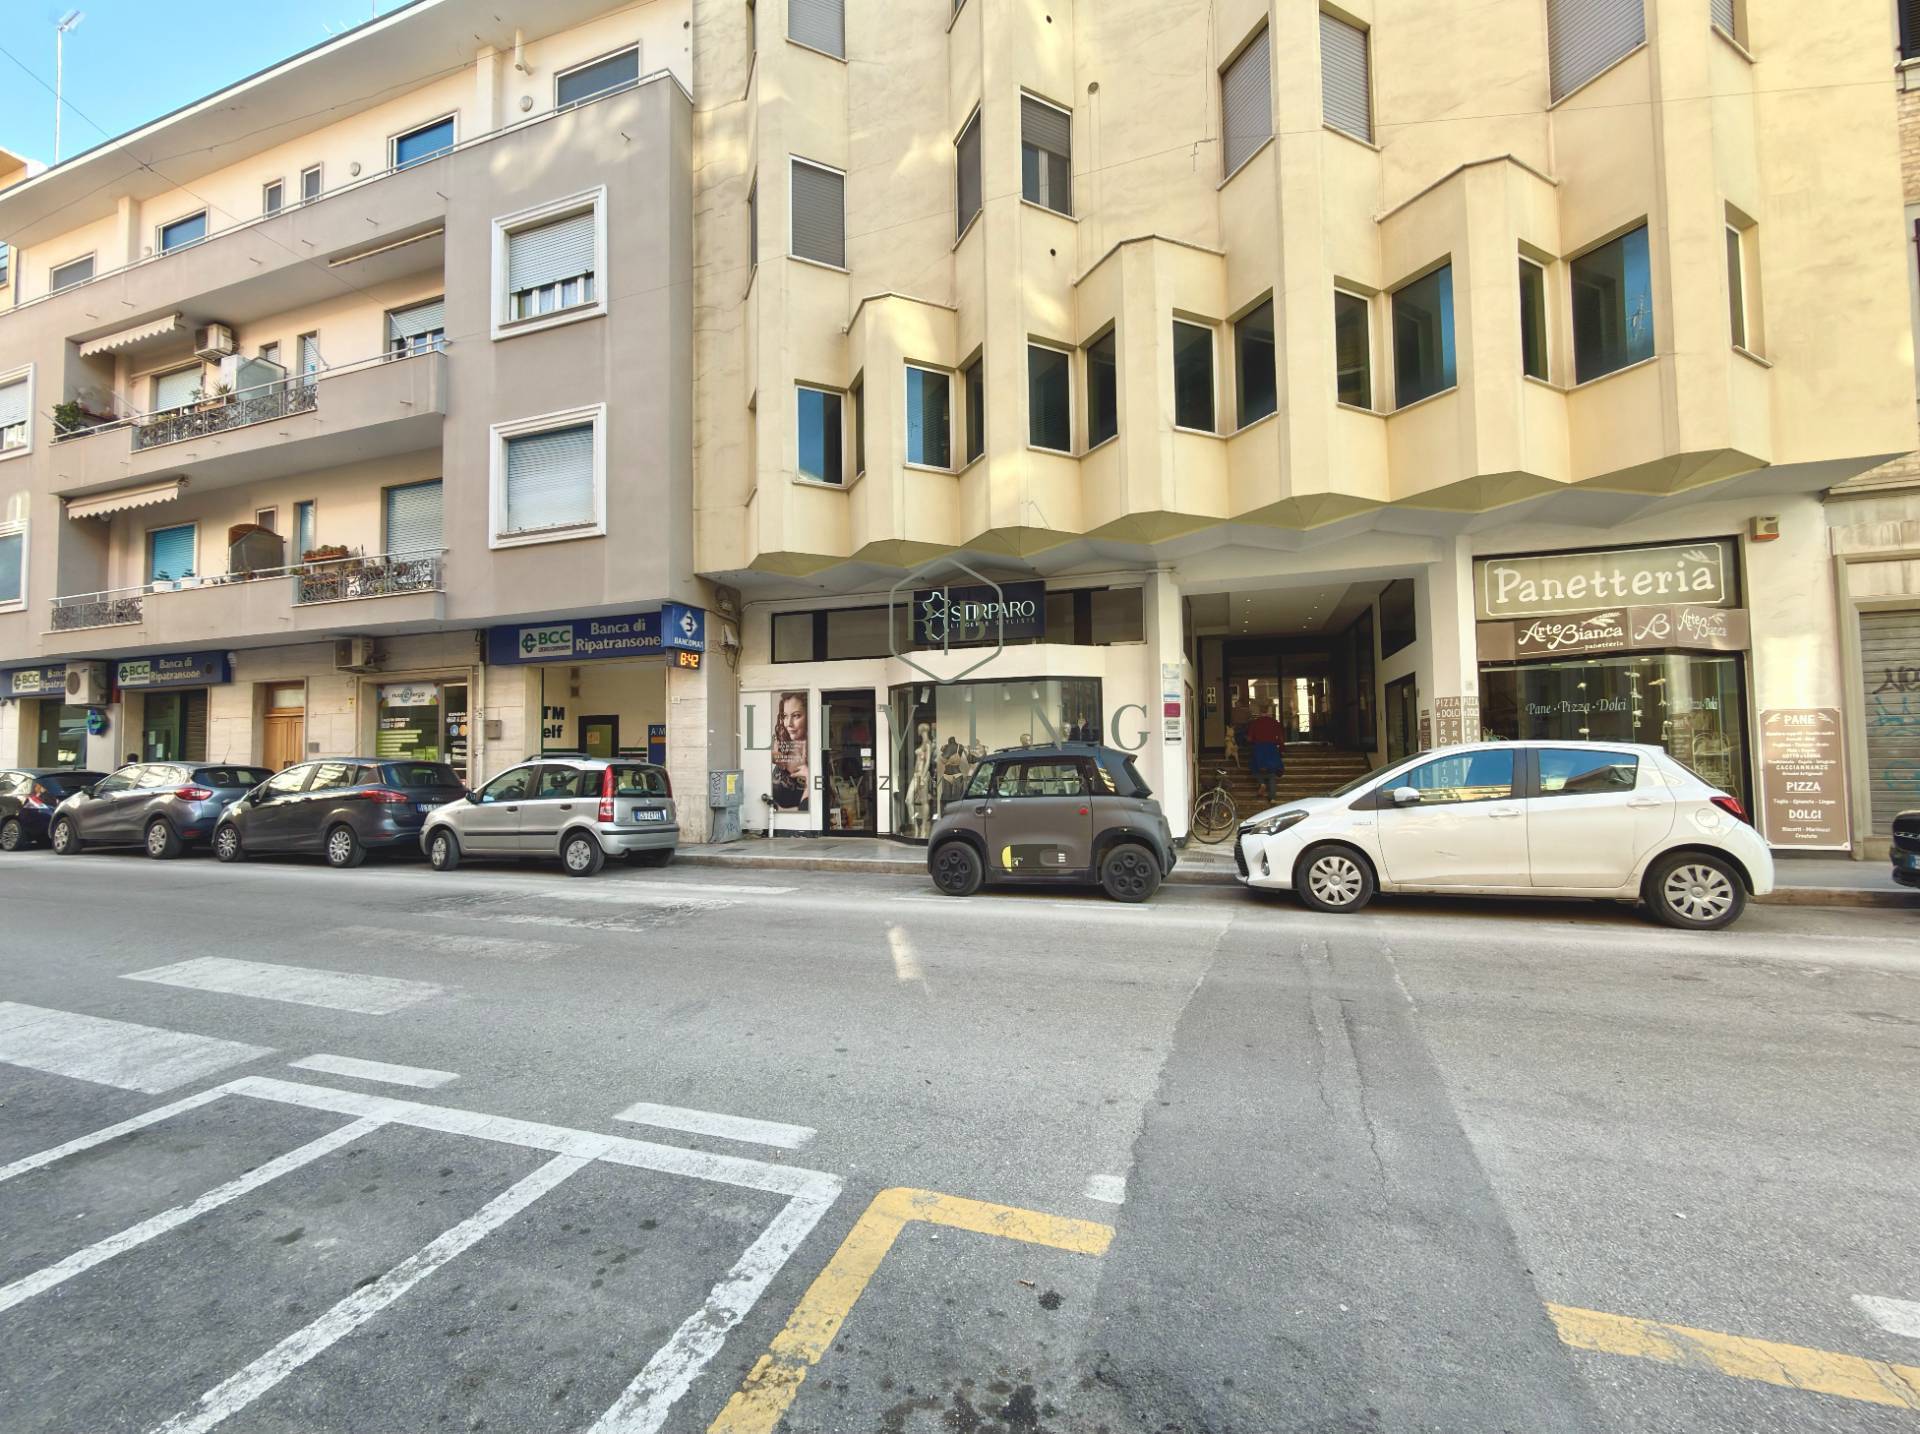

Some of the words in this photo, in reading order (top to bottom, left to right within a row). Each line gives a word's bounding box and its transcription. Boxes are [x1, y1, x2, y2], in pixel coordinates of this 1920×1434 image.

[1494, 560, 1715, 604] Panetteria
[590, 620, 629, 635] Banca
[633, 618, 646, 631] di
[538, 630, 571, 645] BCC
[1518, 620, 1562, 645] Arte
[1547, 624, 1624, 650] Bianca
[575, 634, 661, 654] Ripatransone
[129, 665, 149, 675] BCC
[1527, 701, 1551, 716] Pane
[1558, 700, 1590, 714] Pizza
[1597, 697, 1627, 712] Dolci
[1783, 714, 1817, 725] PANE
[1786, 781, 1821, 792] PIZZA
[1788, 809, 1822, 819] DOLCI
